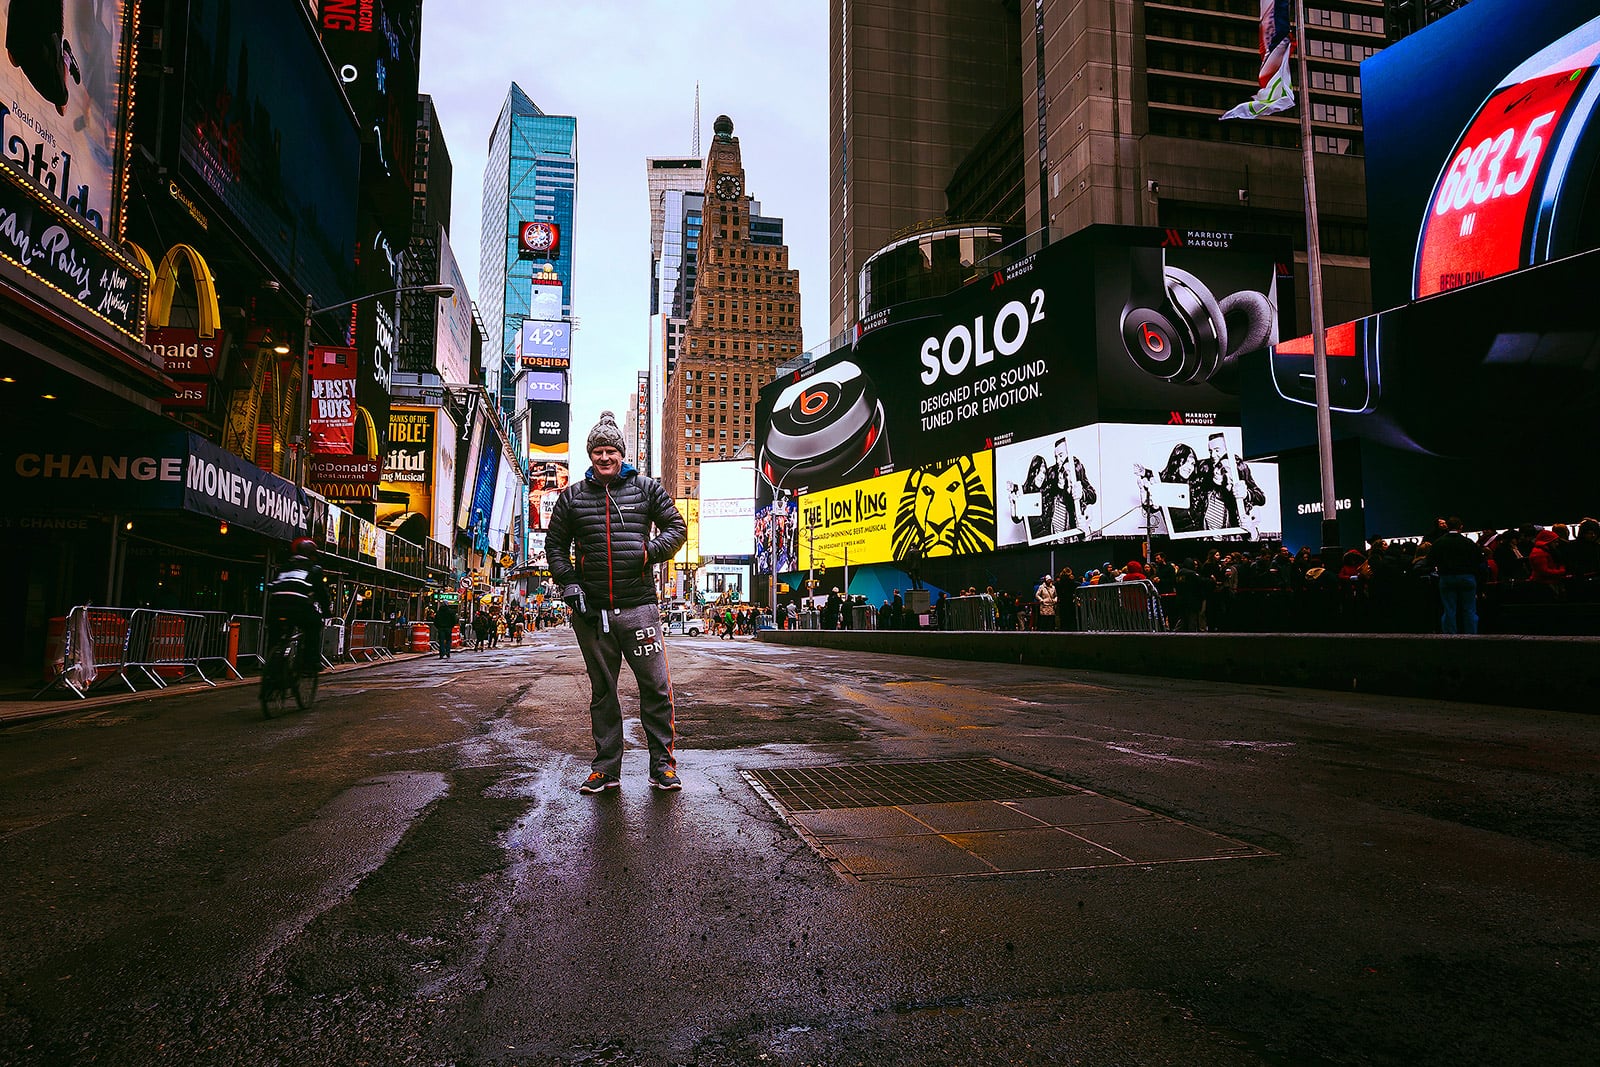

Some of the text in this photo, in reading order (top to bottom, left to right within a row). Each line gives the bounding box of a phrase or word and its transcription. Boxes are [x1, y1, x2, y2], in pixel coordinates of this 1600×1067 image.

[12, 101, 57, 148] Roald Dahl's
[1435, 110, 1557, 216] 683.5
[1459, 212, 1477, 238] MI
[1187, 230, 1235, 241] MARRIOTT
[1187, 239, 1230, 249] MARQUIS
[1006, 253, 1037, 273] MARRIOTT
[1006, 263, 1033, 281] MARQUIS
[99, 268, 128, 291] A New
[1439, 272, 1464, 291] BEGIN
[97, 290, 130, 321] Musical
[863, 308, 892, 324] MARRIOTT
[863, 317, 888, 332] MARQUIS
[522, 357, 569, 367] TOSHIBA
[311, 379, 357, 399] JERSEY
[536, 382, 561, 391] TDK
[920, 359, 1049, 415] DESIGNED FOR SOUND.
[318, 398, 352, 419] BOYS
[920, 381, 1043, 432] TUNED FOR EMOTION.
[409, 415, 417, 424] OF
[417, 415, 428, 424] THE
[15, 453, 183, 482] CHANGE
[309, 462, 378, 474] McDonald's
[316, 472, 366, 481] Restaurant
[394, 472, 425, 482] Musical
[186, 454, 253, 510] MONEY
[256, 485, 308, 530] CHANGE
[803, 505, 822, 526] THE
[1296, 498, 1352, 515] SAMNG
[19, 517, 89, 529] CHANGE
[635, 626, 656, 641] SD
[633, 640, 663, 657] JPN
